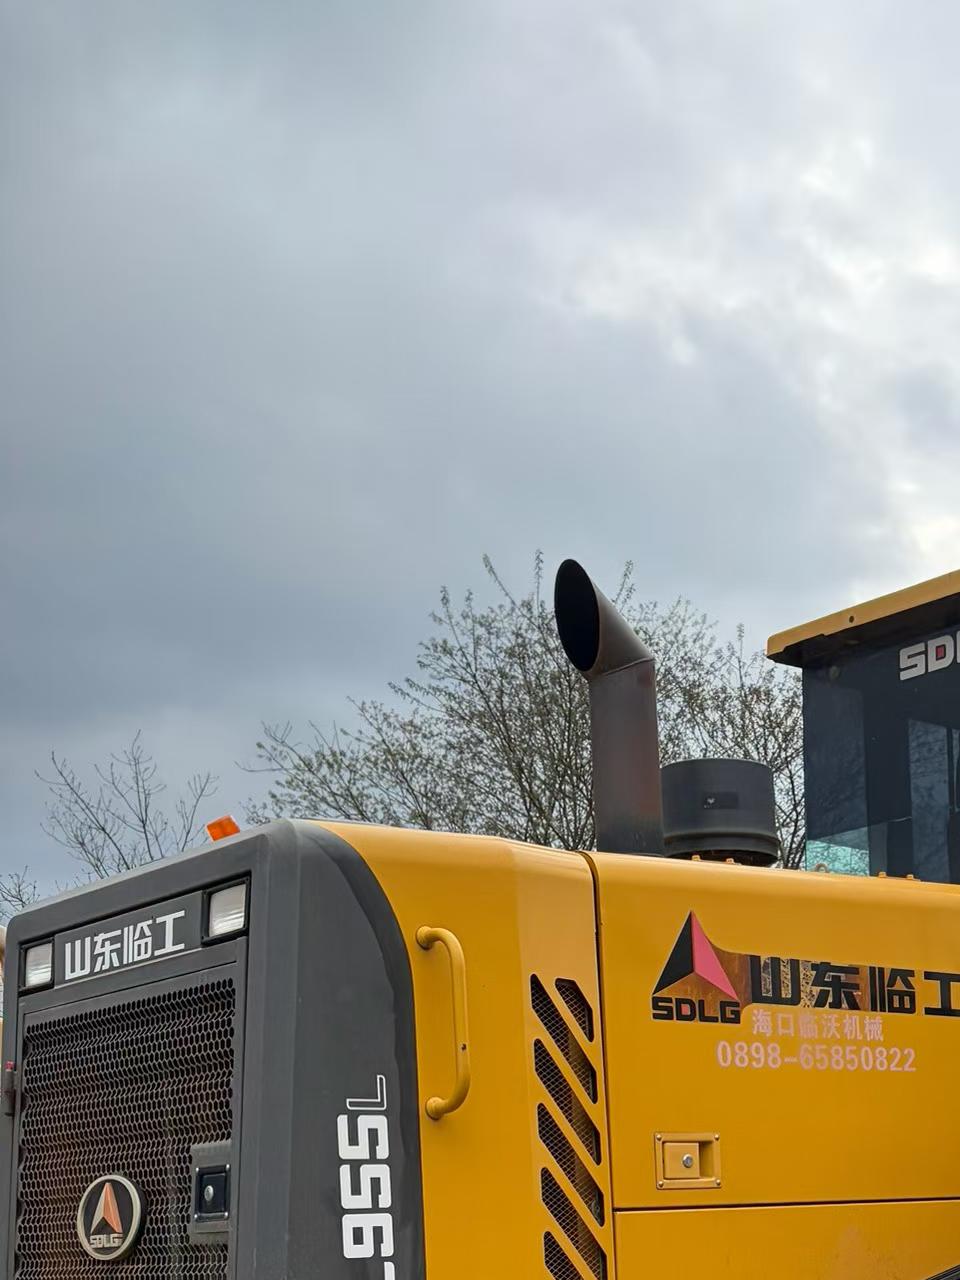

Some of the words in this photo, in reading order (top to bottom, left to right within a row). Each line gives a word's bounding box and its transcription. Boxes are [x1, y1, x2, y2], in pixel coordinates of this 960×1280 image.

[65, 910, 185, 980] 山东临工
[651, 996, 741, 1025] SDLG
[716, 1040, 916, 1072] 0898-65850822
[89, 1233, 124, 1249] SDLG
